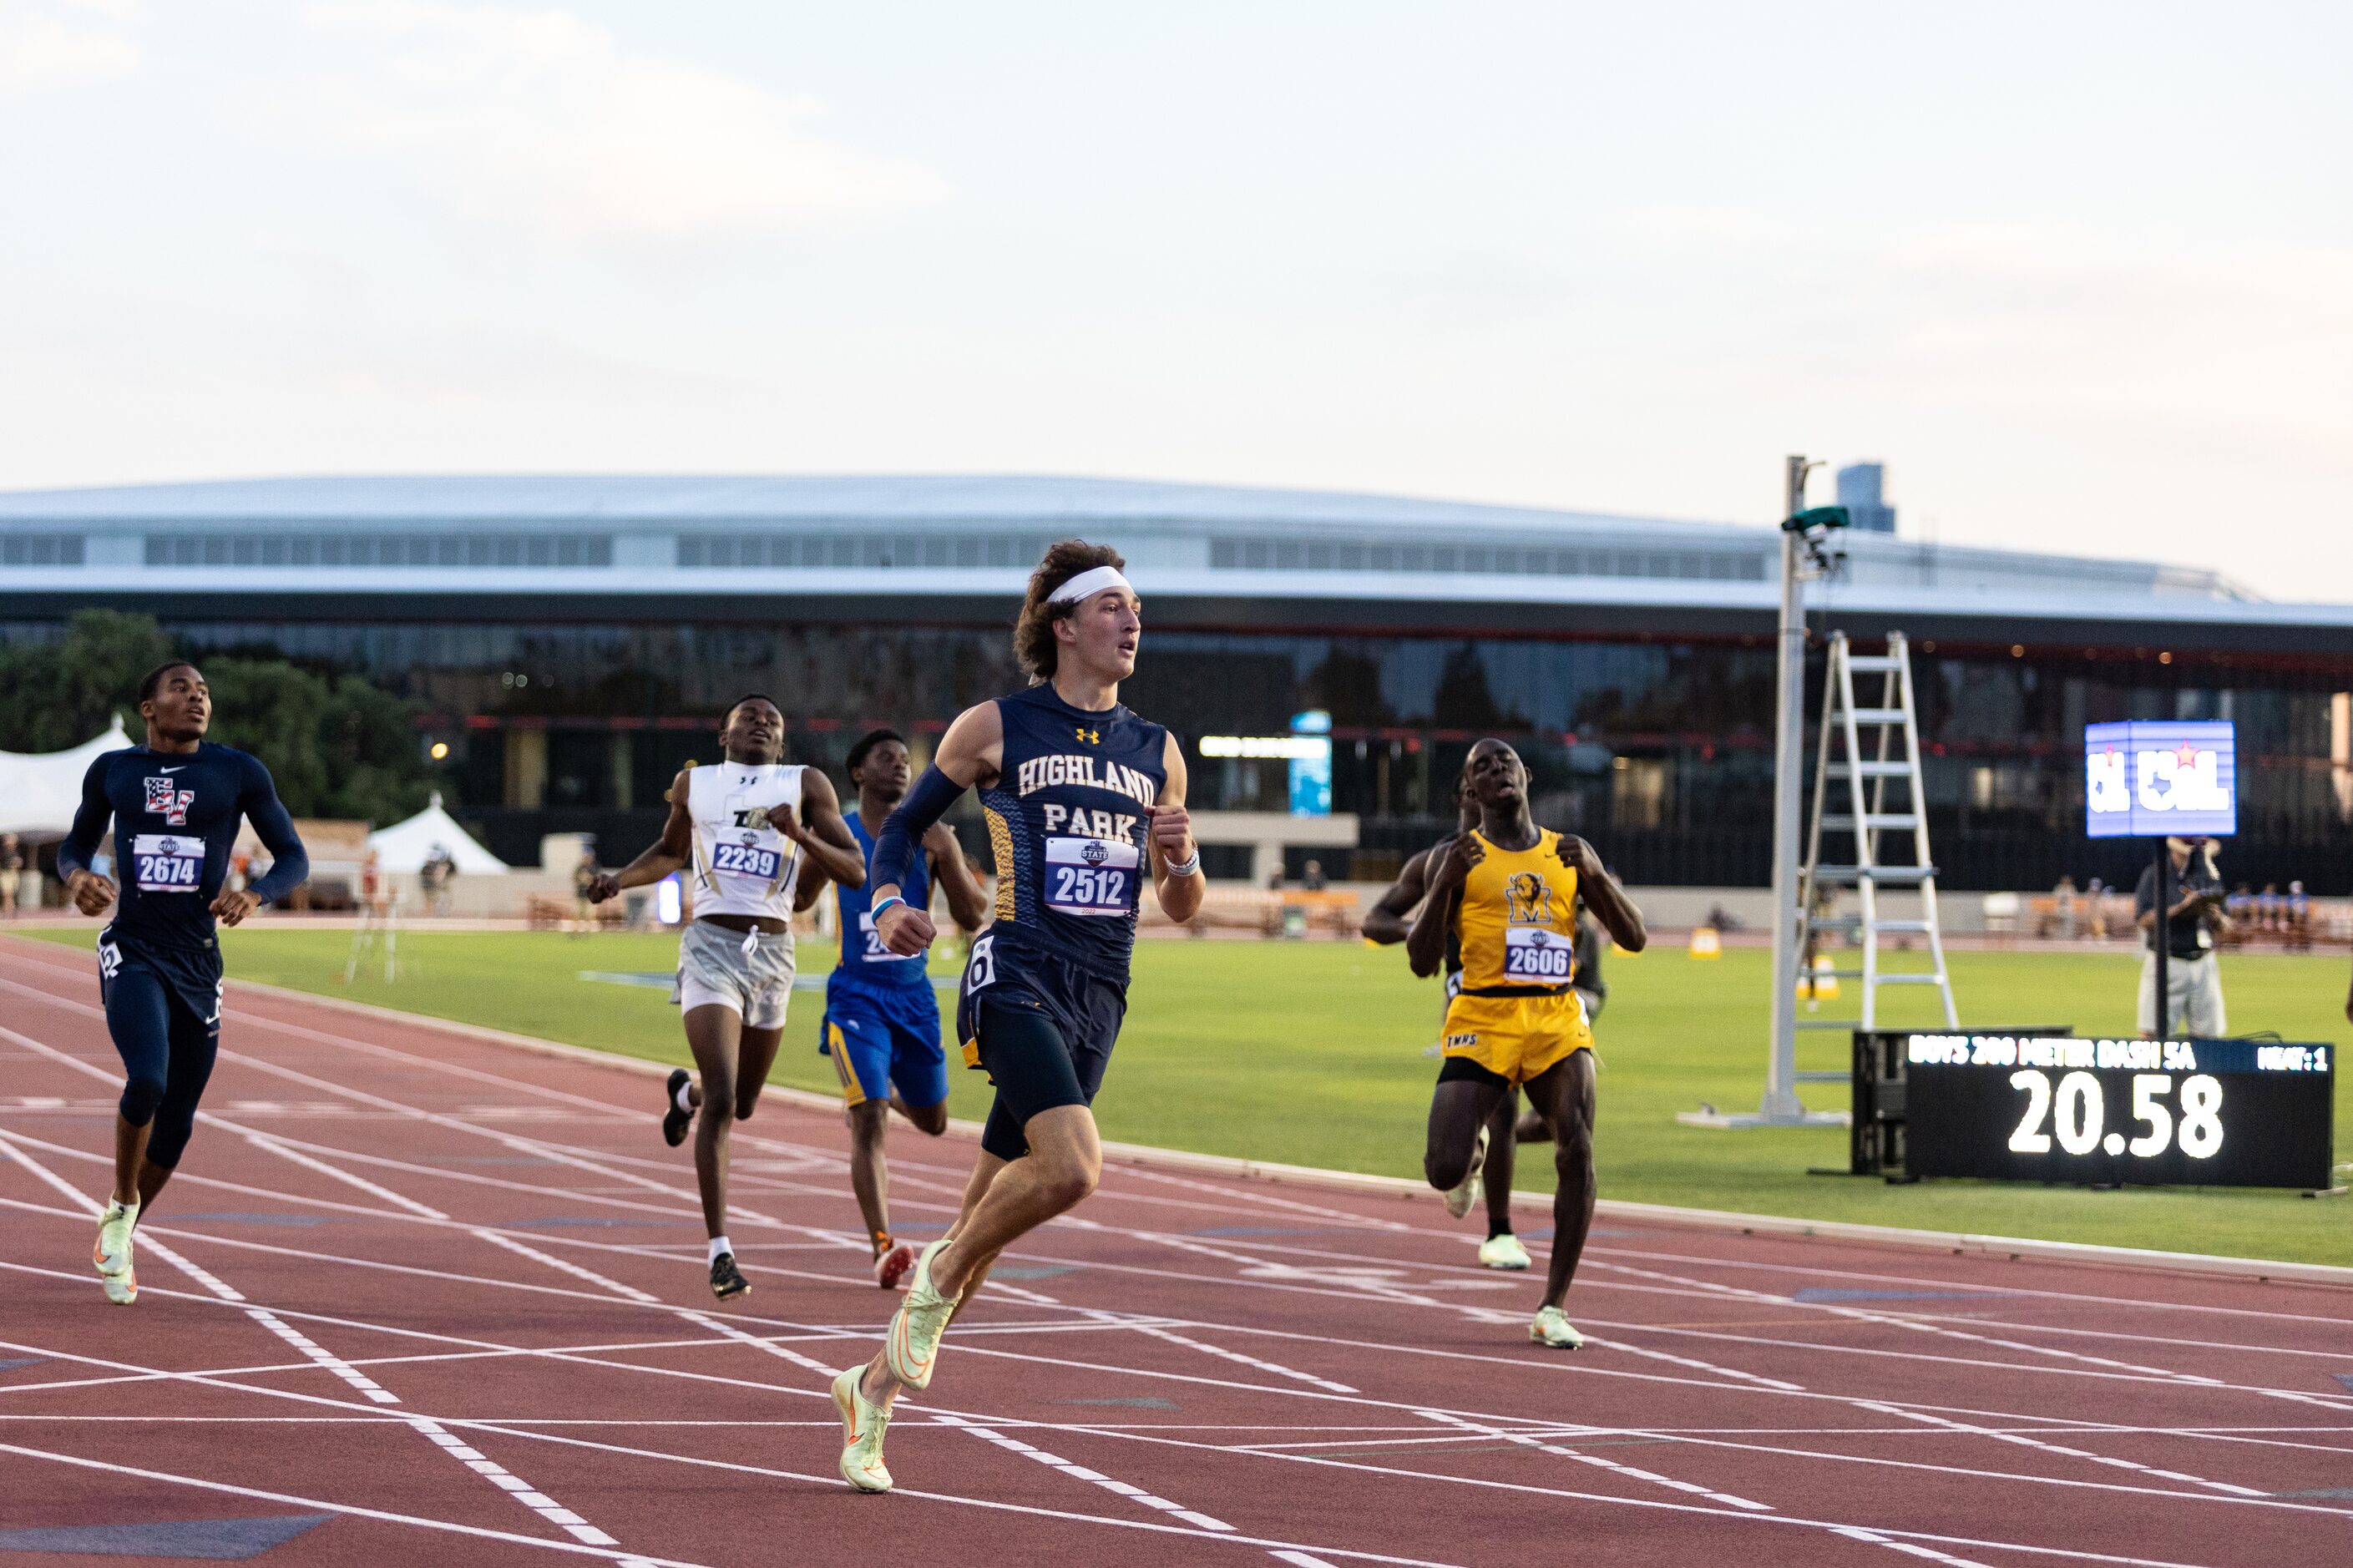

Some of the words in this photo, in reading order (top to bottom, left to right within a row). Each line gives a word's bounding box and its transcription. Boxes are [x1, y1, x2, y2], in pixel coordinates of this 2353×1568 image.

[1018, 754, 1156, 807] HIGHLAND
[144, 776, 195, 826] EV
[1044, 803, 1136, 845] PARK
[139, 855, 195, 884] 2674
[716, 845, 776, 877] 2239
[1081, 850, 1109, 859] STATE
[1055, 867, 1126, 905] 2512
[1505, 888, 1552, 924] M
[970, 943, 988, 988] 6
[1509, 946, 1568, 976] 2606
[1908, 1034, 1970, 1065] BOYS
[1971, 1036, 2017, 1065] 200
[2017, 1037, 2096, 1068] METER
[2097, 1039, 2161, 1069] DASH
[2163, 1041, 2197, 1070] 5A
[2008, 1069, 2224, 1159] 20.58
